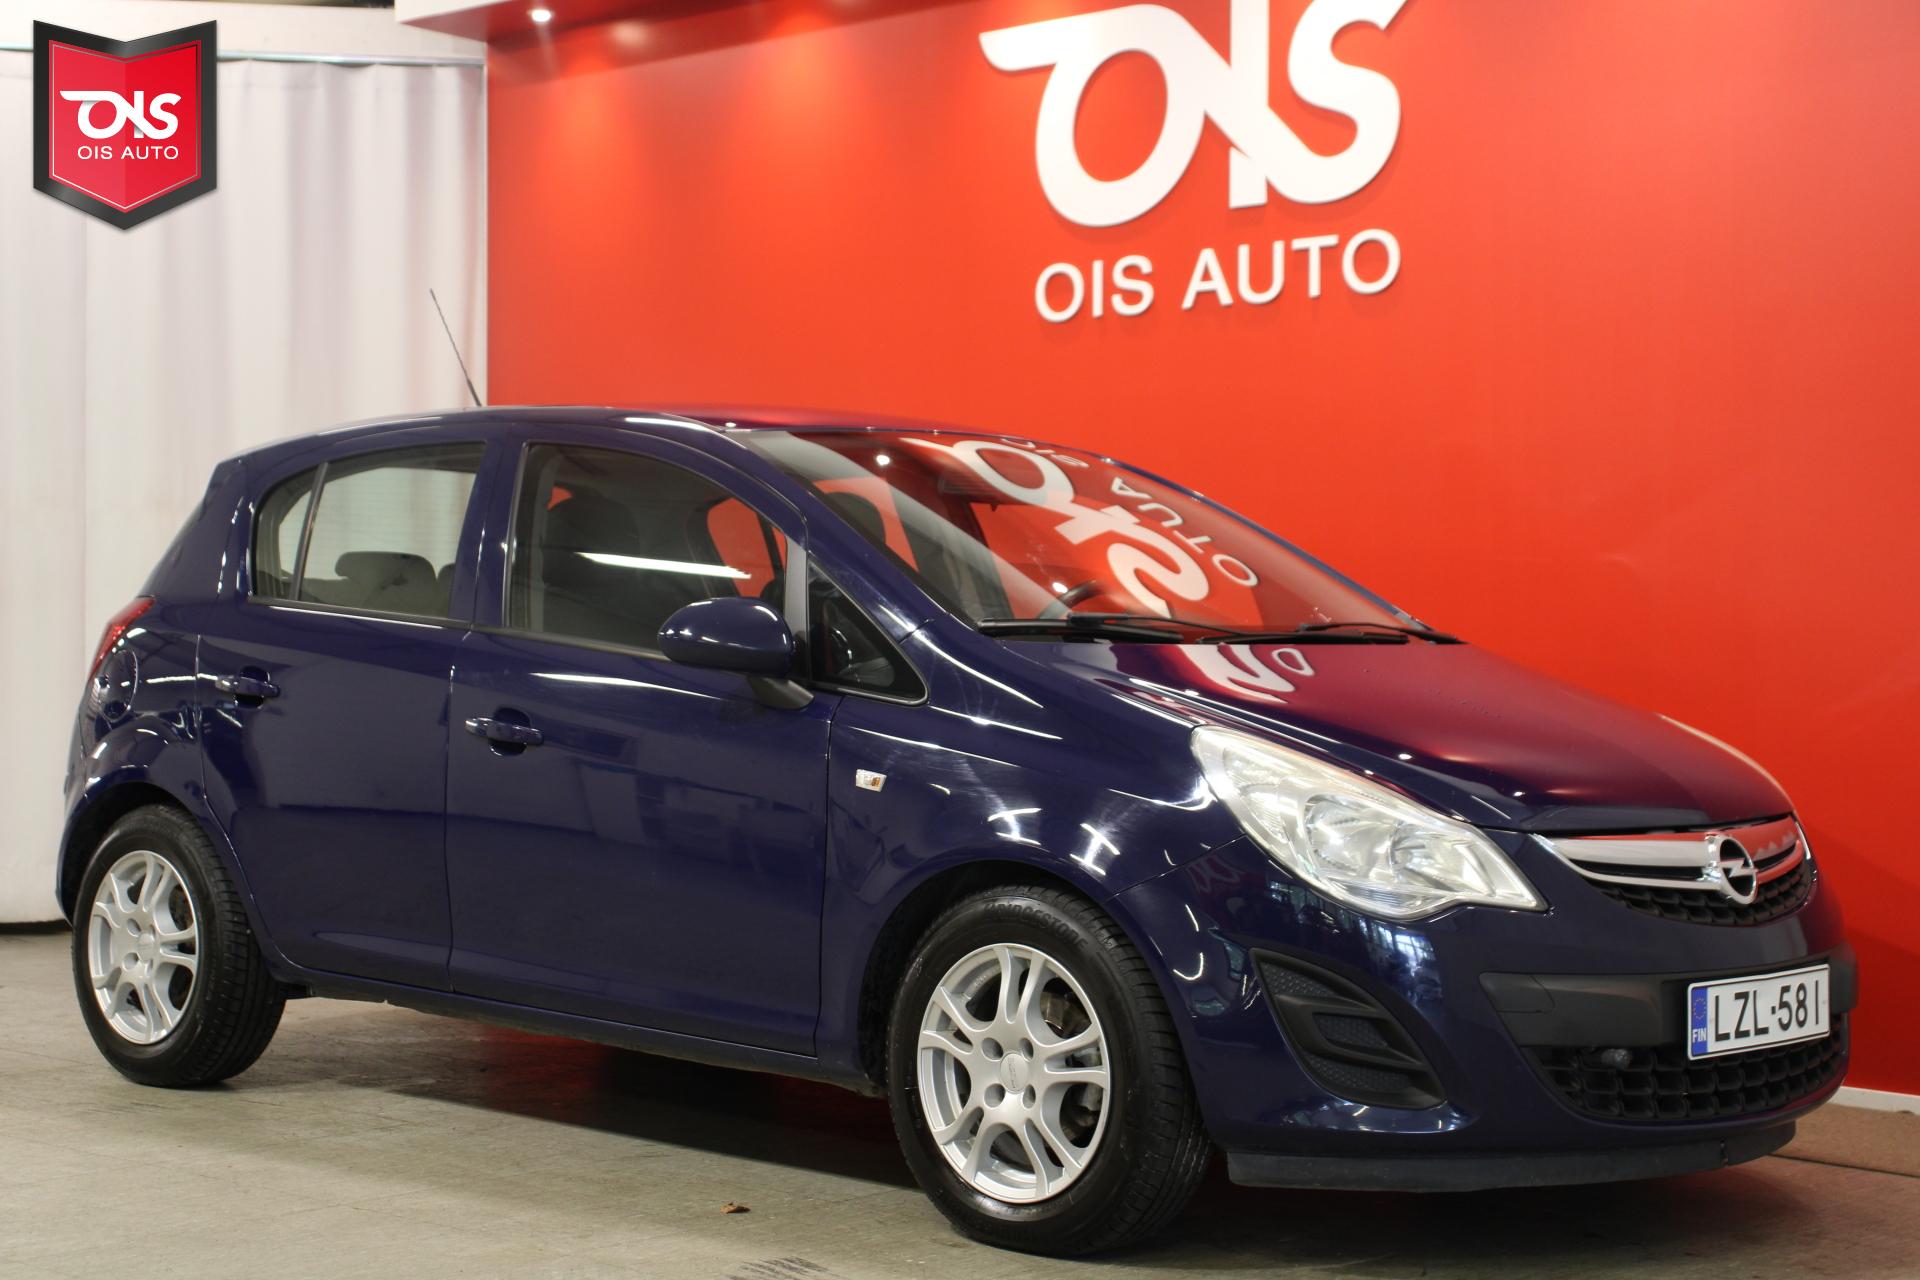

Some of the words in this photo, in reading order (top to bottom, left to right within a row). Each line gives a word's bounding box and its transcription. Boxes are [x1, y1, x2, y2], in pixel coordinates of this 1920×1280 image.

[1035, 255, 1154, 323] OIS
[1181, 228, 1401, 310] AUTO
[1692, 1027, 1708, 1044] FIN
[1714, 980, 1820, 1043] LZL-581
